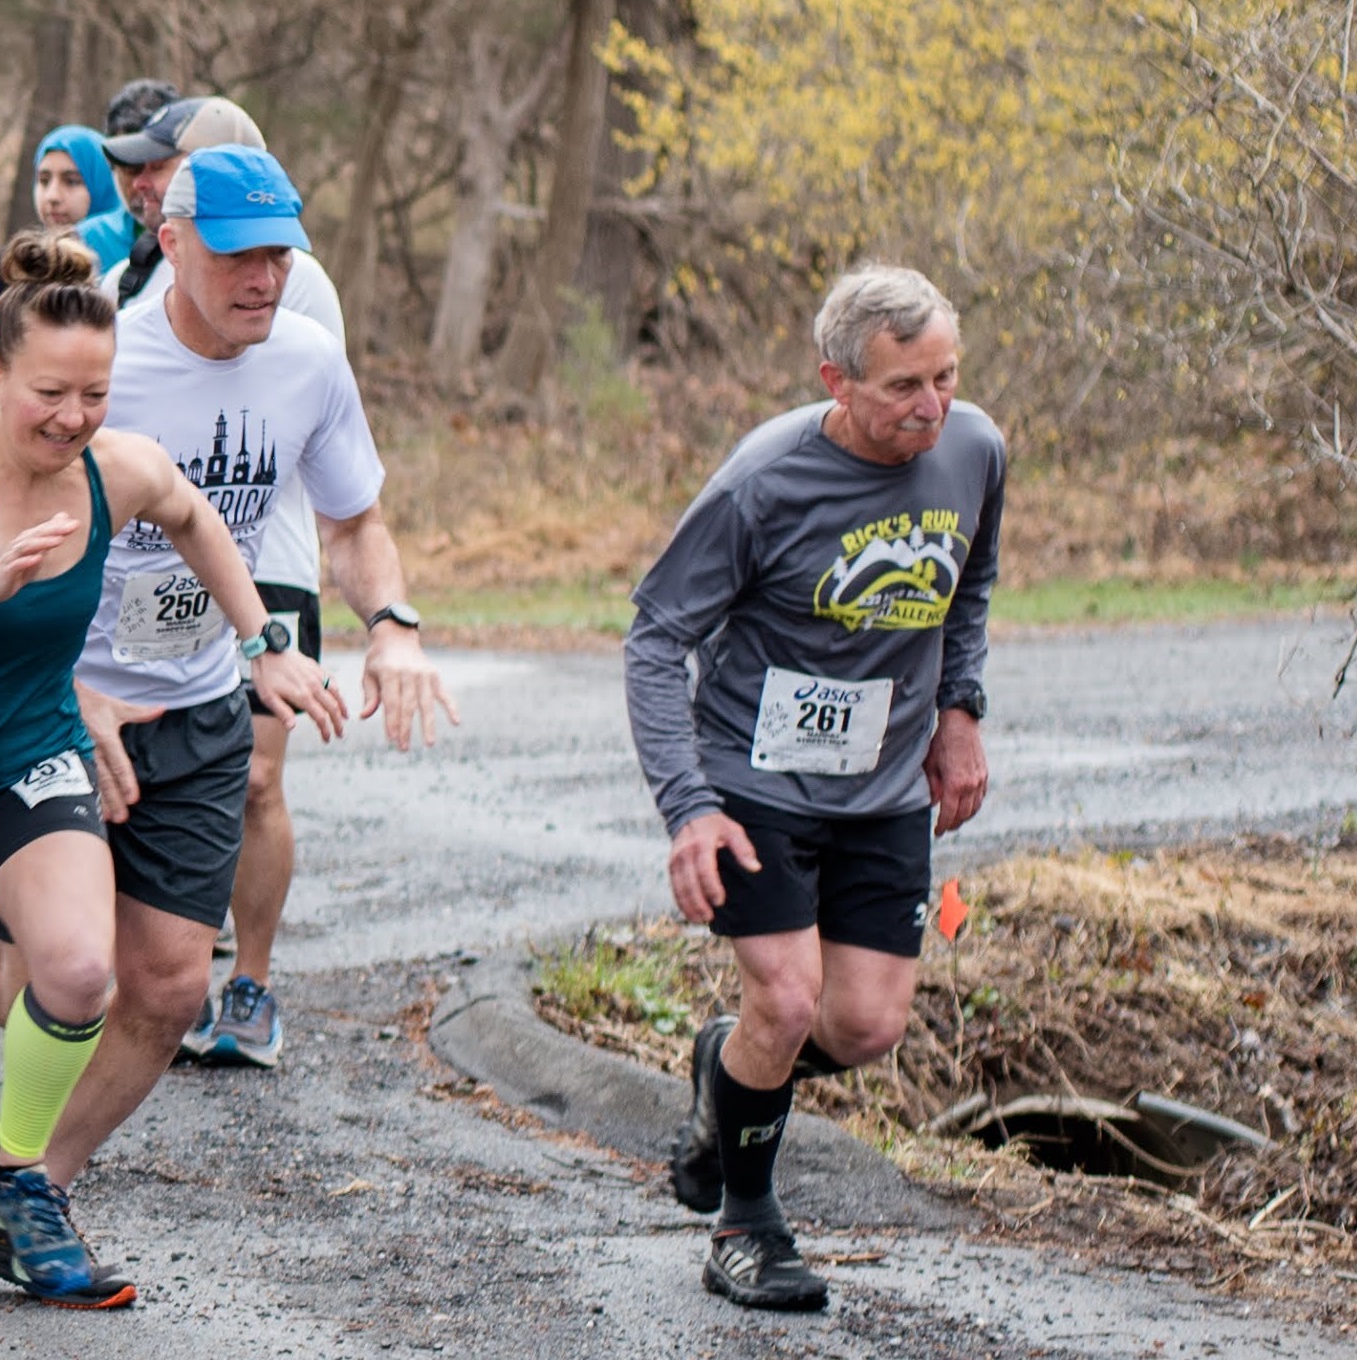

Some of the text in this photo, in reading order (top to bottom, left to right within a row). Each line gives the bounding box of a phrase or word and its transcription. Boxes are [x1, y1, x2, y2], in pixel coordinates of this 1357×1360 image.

[841, 509, 960, 554] RICK'S RUN
[156, 590, 210, 622] 250
[817, 688, 864, 704] asics
[796, 702, 853, 733] 261
